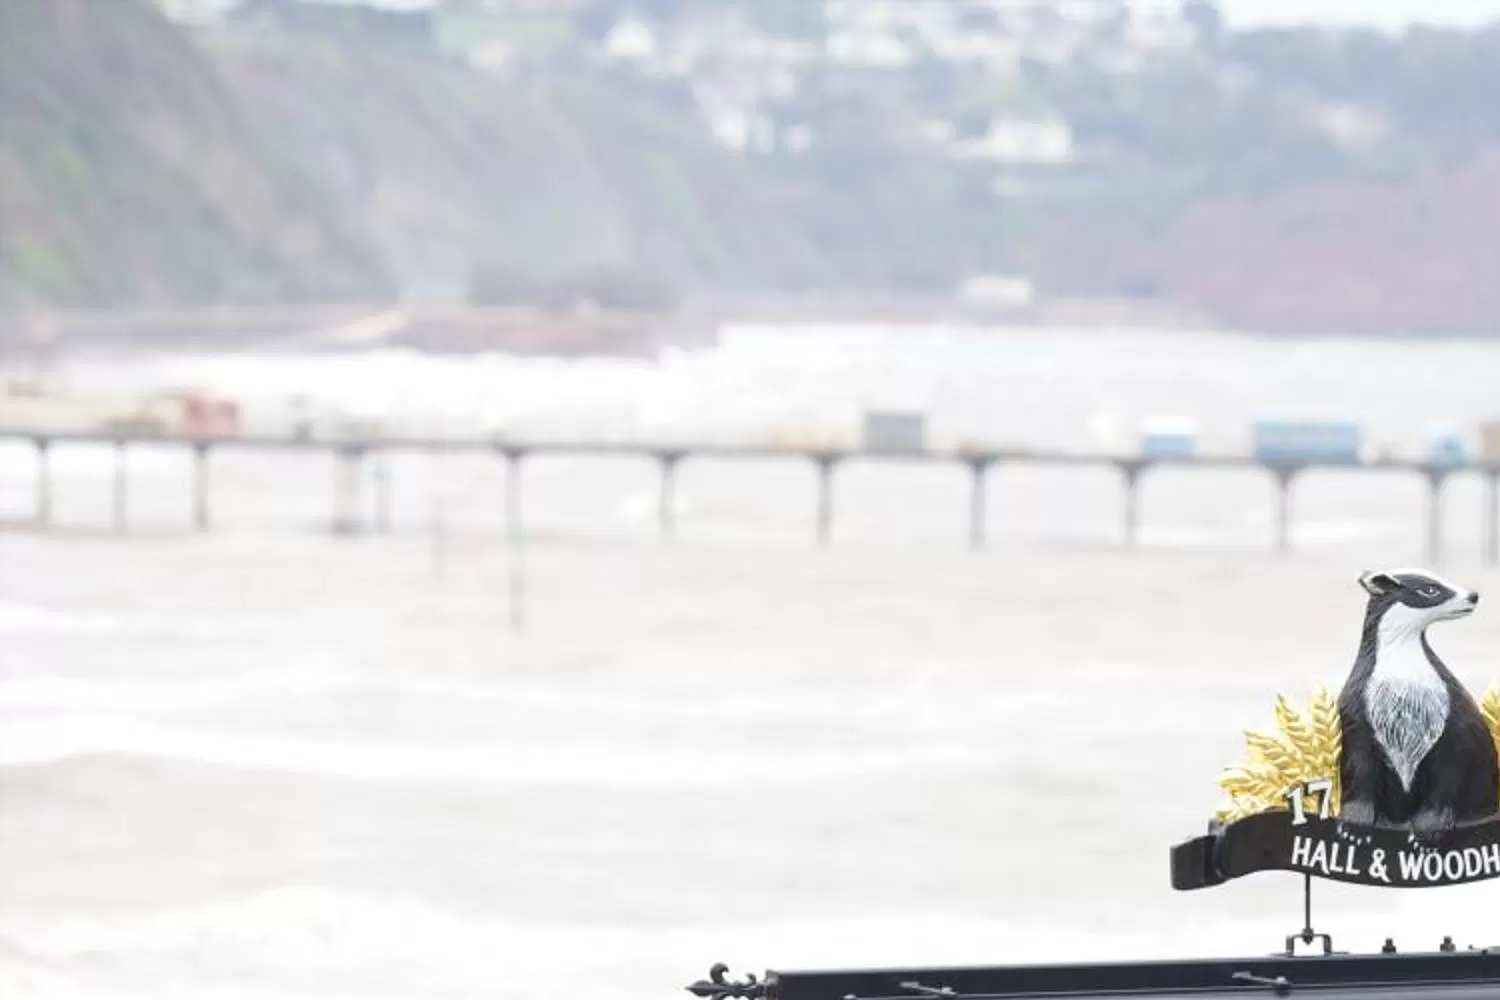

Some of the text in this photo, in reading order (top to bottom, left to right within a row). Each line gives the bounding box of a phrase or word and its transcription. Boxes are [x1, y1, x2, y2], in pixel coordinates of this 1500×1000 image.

[1286, 778, 1335, 826] 17
[1291, 835, 1361, 878] HALL
[1368, 848, 1392, 883] &
